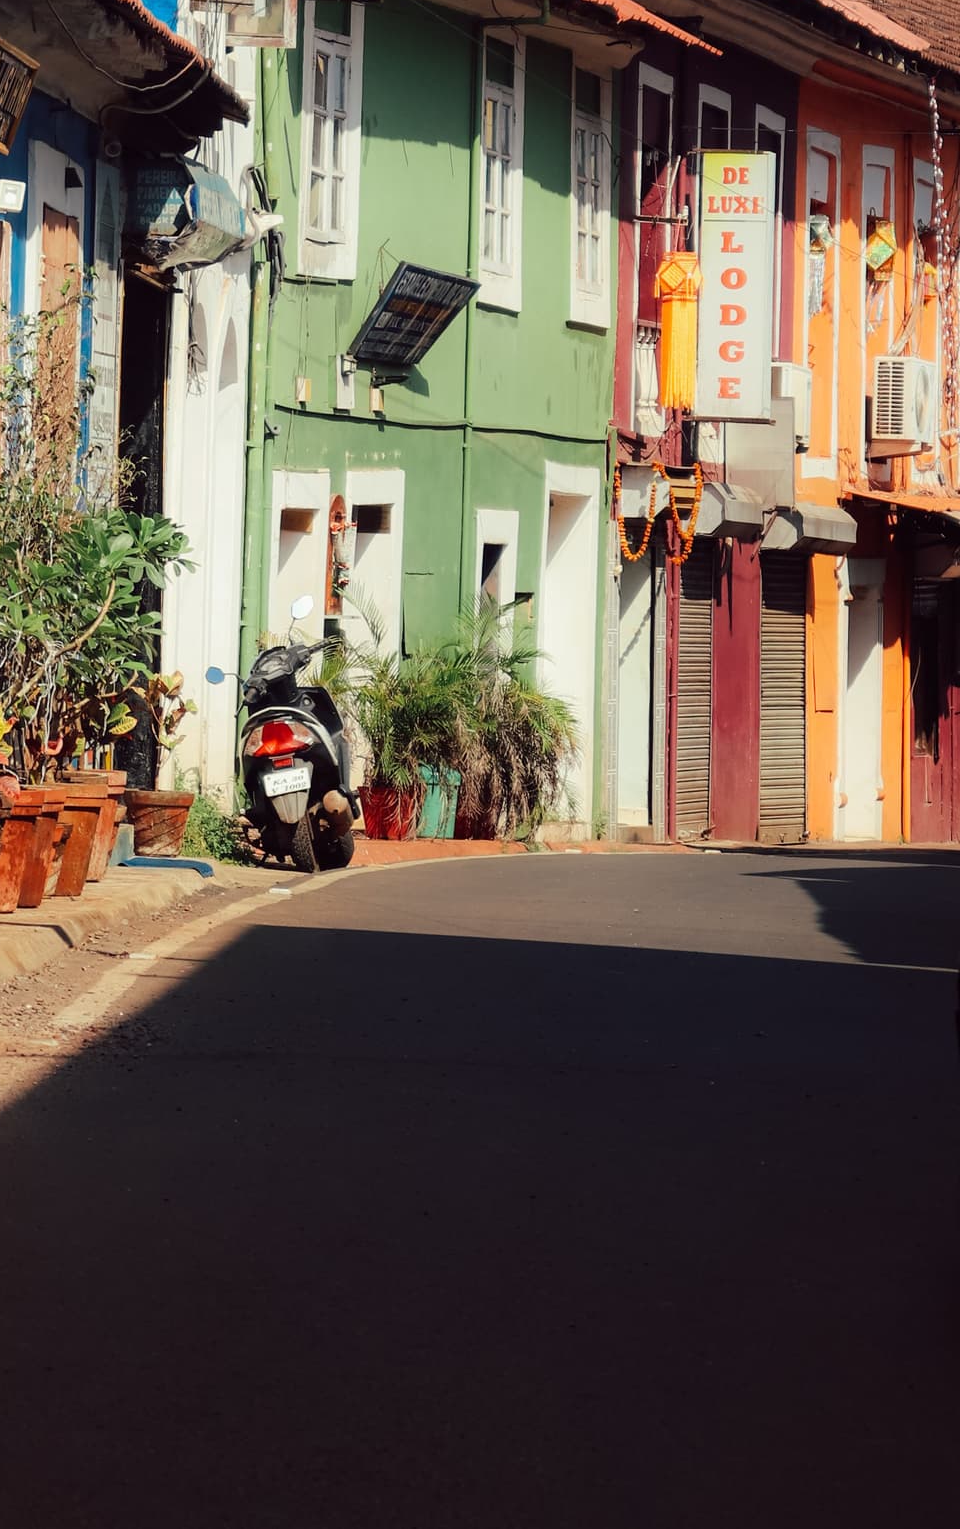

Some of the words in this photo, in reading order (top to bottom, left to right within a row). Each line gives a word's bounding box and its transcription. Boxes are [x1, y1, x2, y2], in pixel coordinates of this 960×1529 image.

[723, 168, 749, 184] DE
[708, 196, 764, 214] LUXE
[718, 232, 748, 399] LODGE
